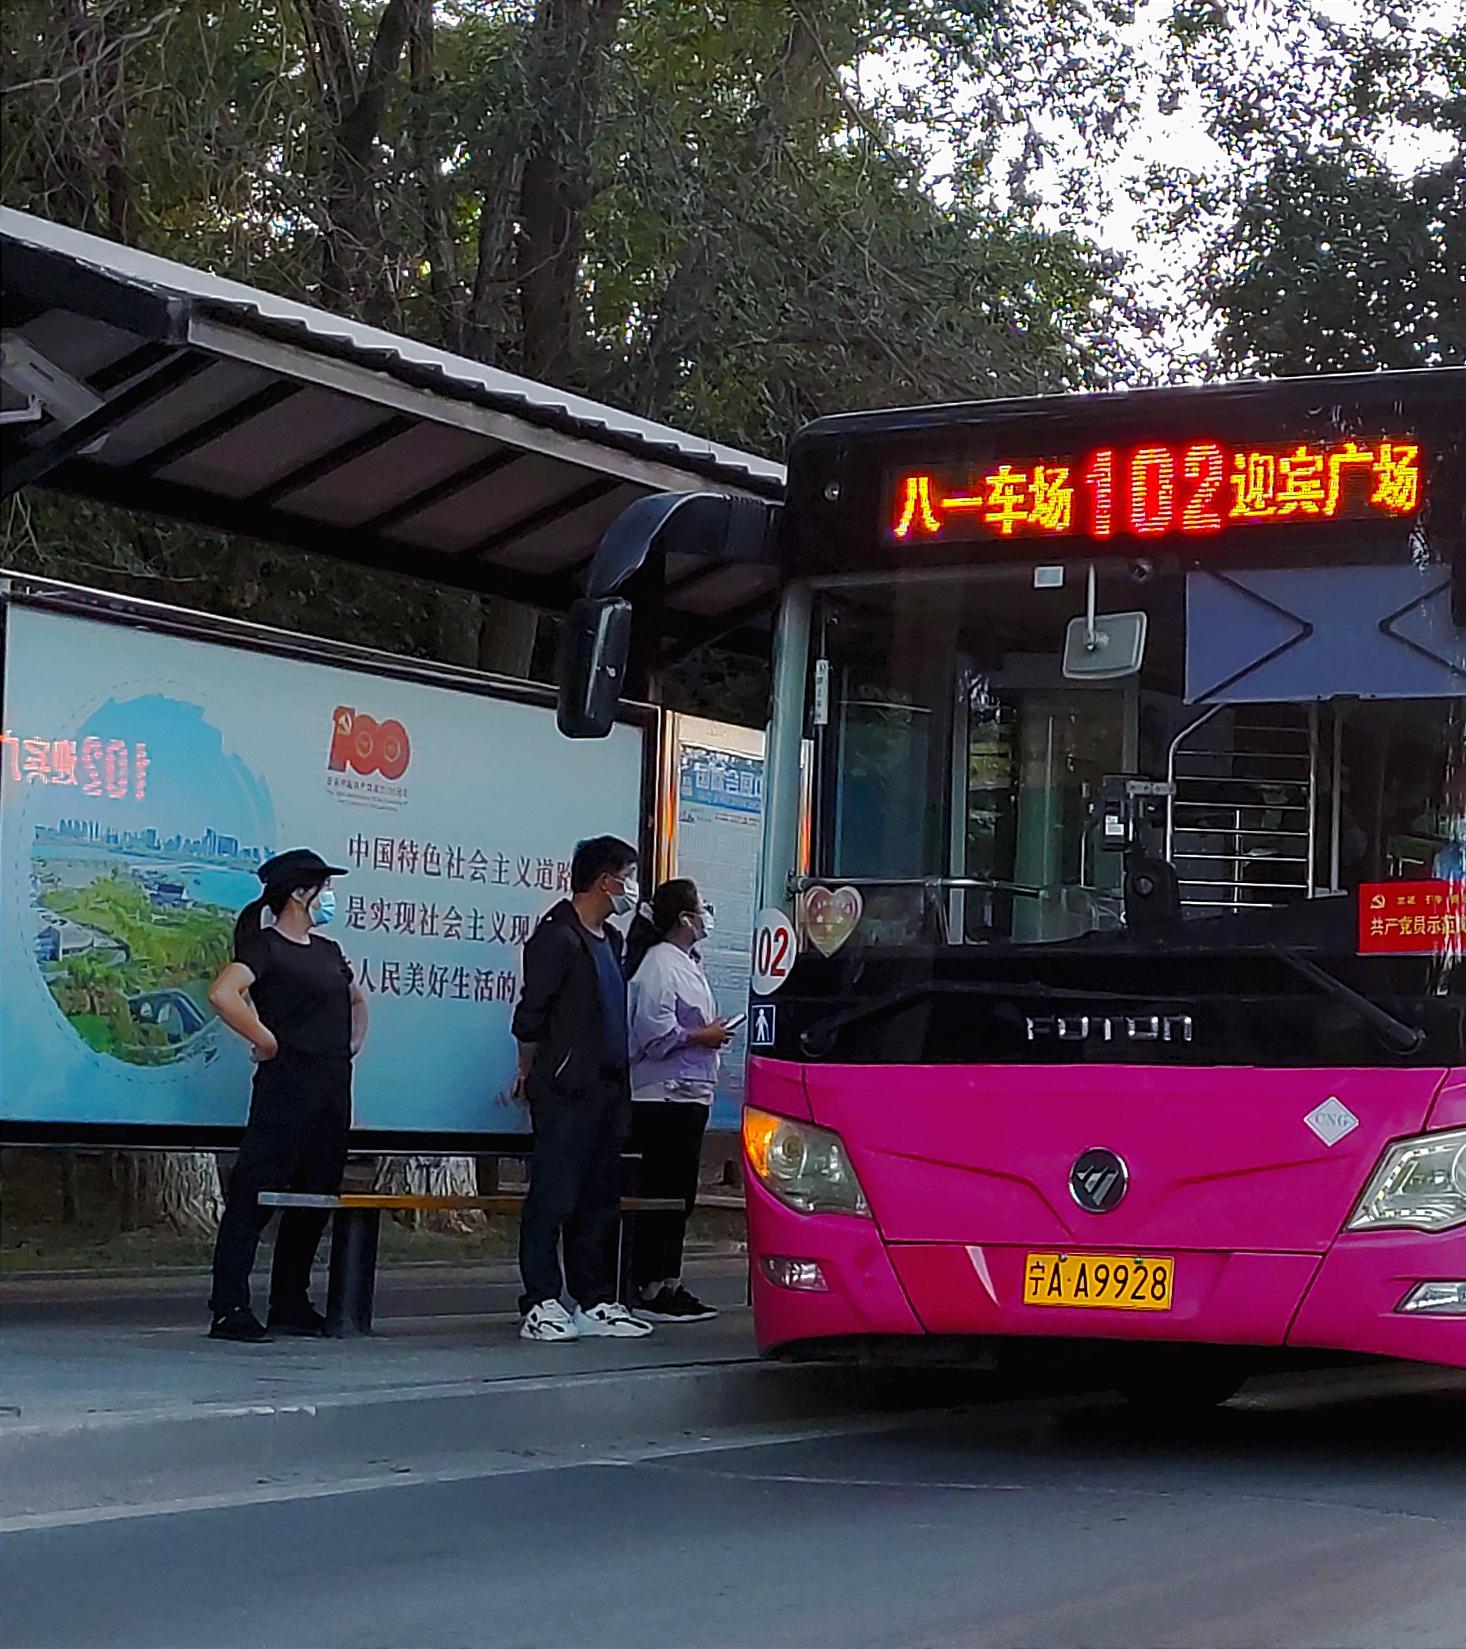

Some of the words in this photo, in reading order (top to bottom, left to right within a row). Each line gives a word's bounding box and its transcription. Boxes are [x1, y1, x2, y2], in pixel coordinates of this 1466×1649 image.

[893, 465, 1073, 537] 八一车场
[1085, 443, 1224, 535] 102
[1229, 443, 1420, 519] 迎宾广场
[345, 894, 543, 946] 是实现社会主义现
[1025, 1015, 1193, 1042] FOTON
[1315, 1111, 1349, 1129] CNG
